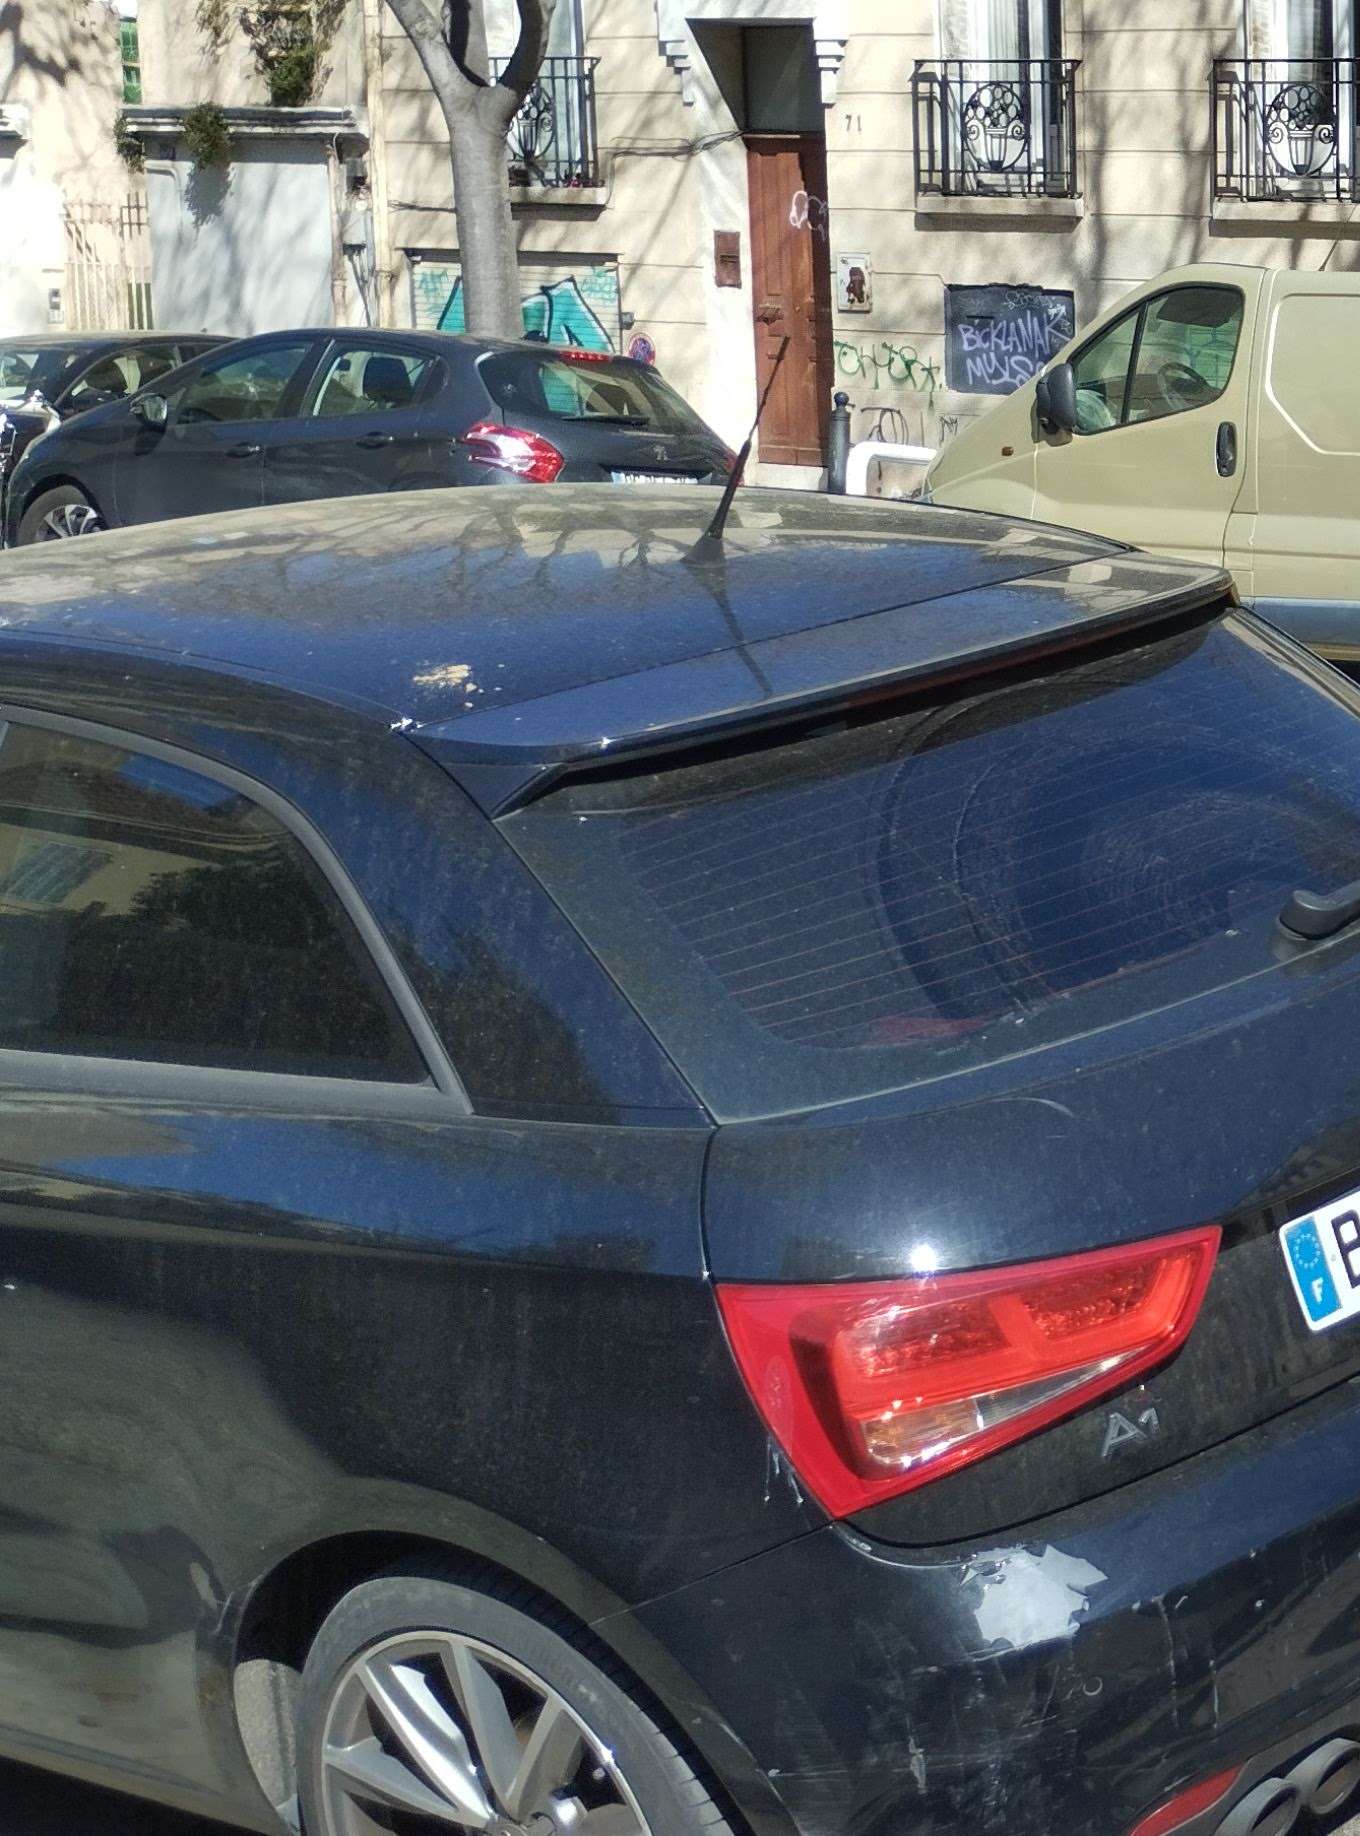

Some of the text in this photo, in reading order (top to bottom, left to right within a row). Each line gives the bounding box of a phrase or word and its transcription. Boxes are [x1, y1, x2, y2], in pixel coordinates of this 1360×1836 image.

[845, 113, 862, 132] 71
[1311, 1276, 1324, 1303] F
[1101, 1407, 1160, 1457] A1
